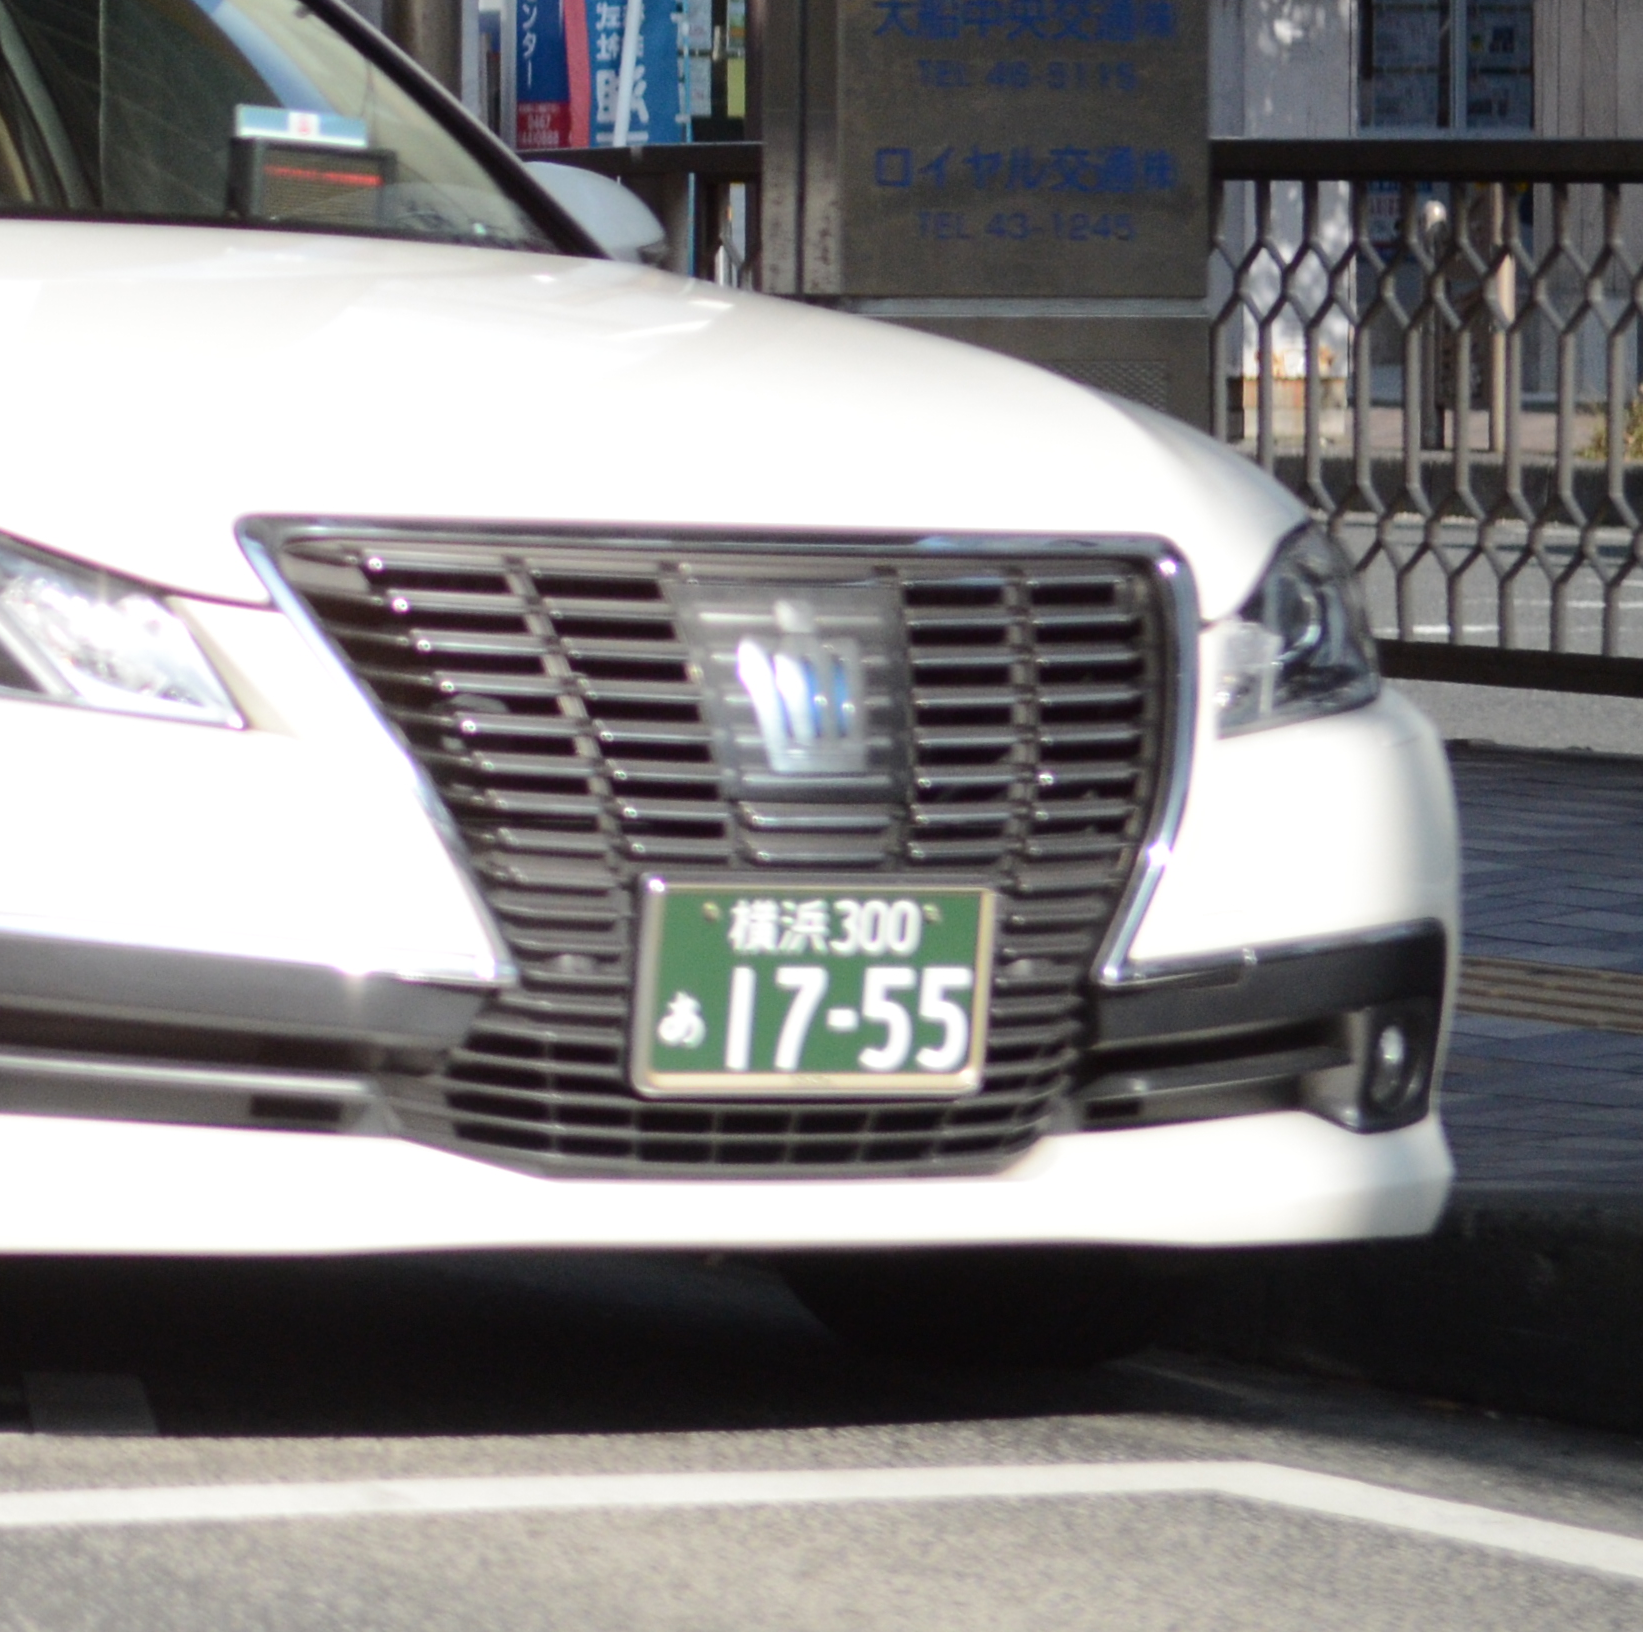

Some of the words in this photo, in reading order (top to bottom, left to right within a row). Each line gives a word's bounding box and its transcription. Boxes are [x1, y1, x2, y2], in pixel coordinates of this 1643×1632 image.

[917, 211, 973, 241] TEL
[657, 991, 707, 1050] あ
[725, 965, 974, 1071] 17-55
